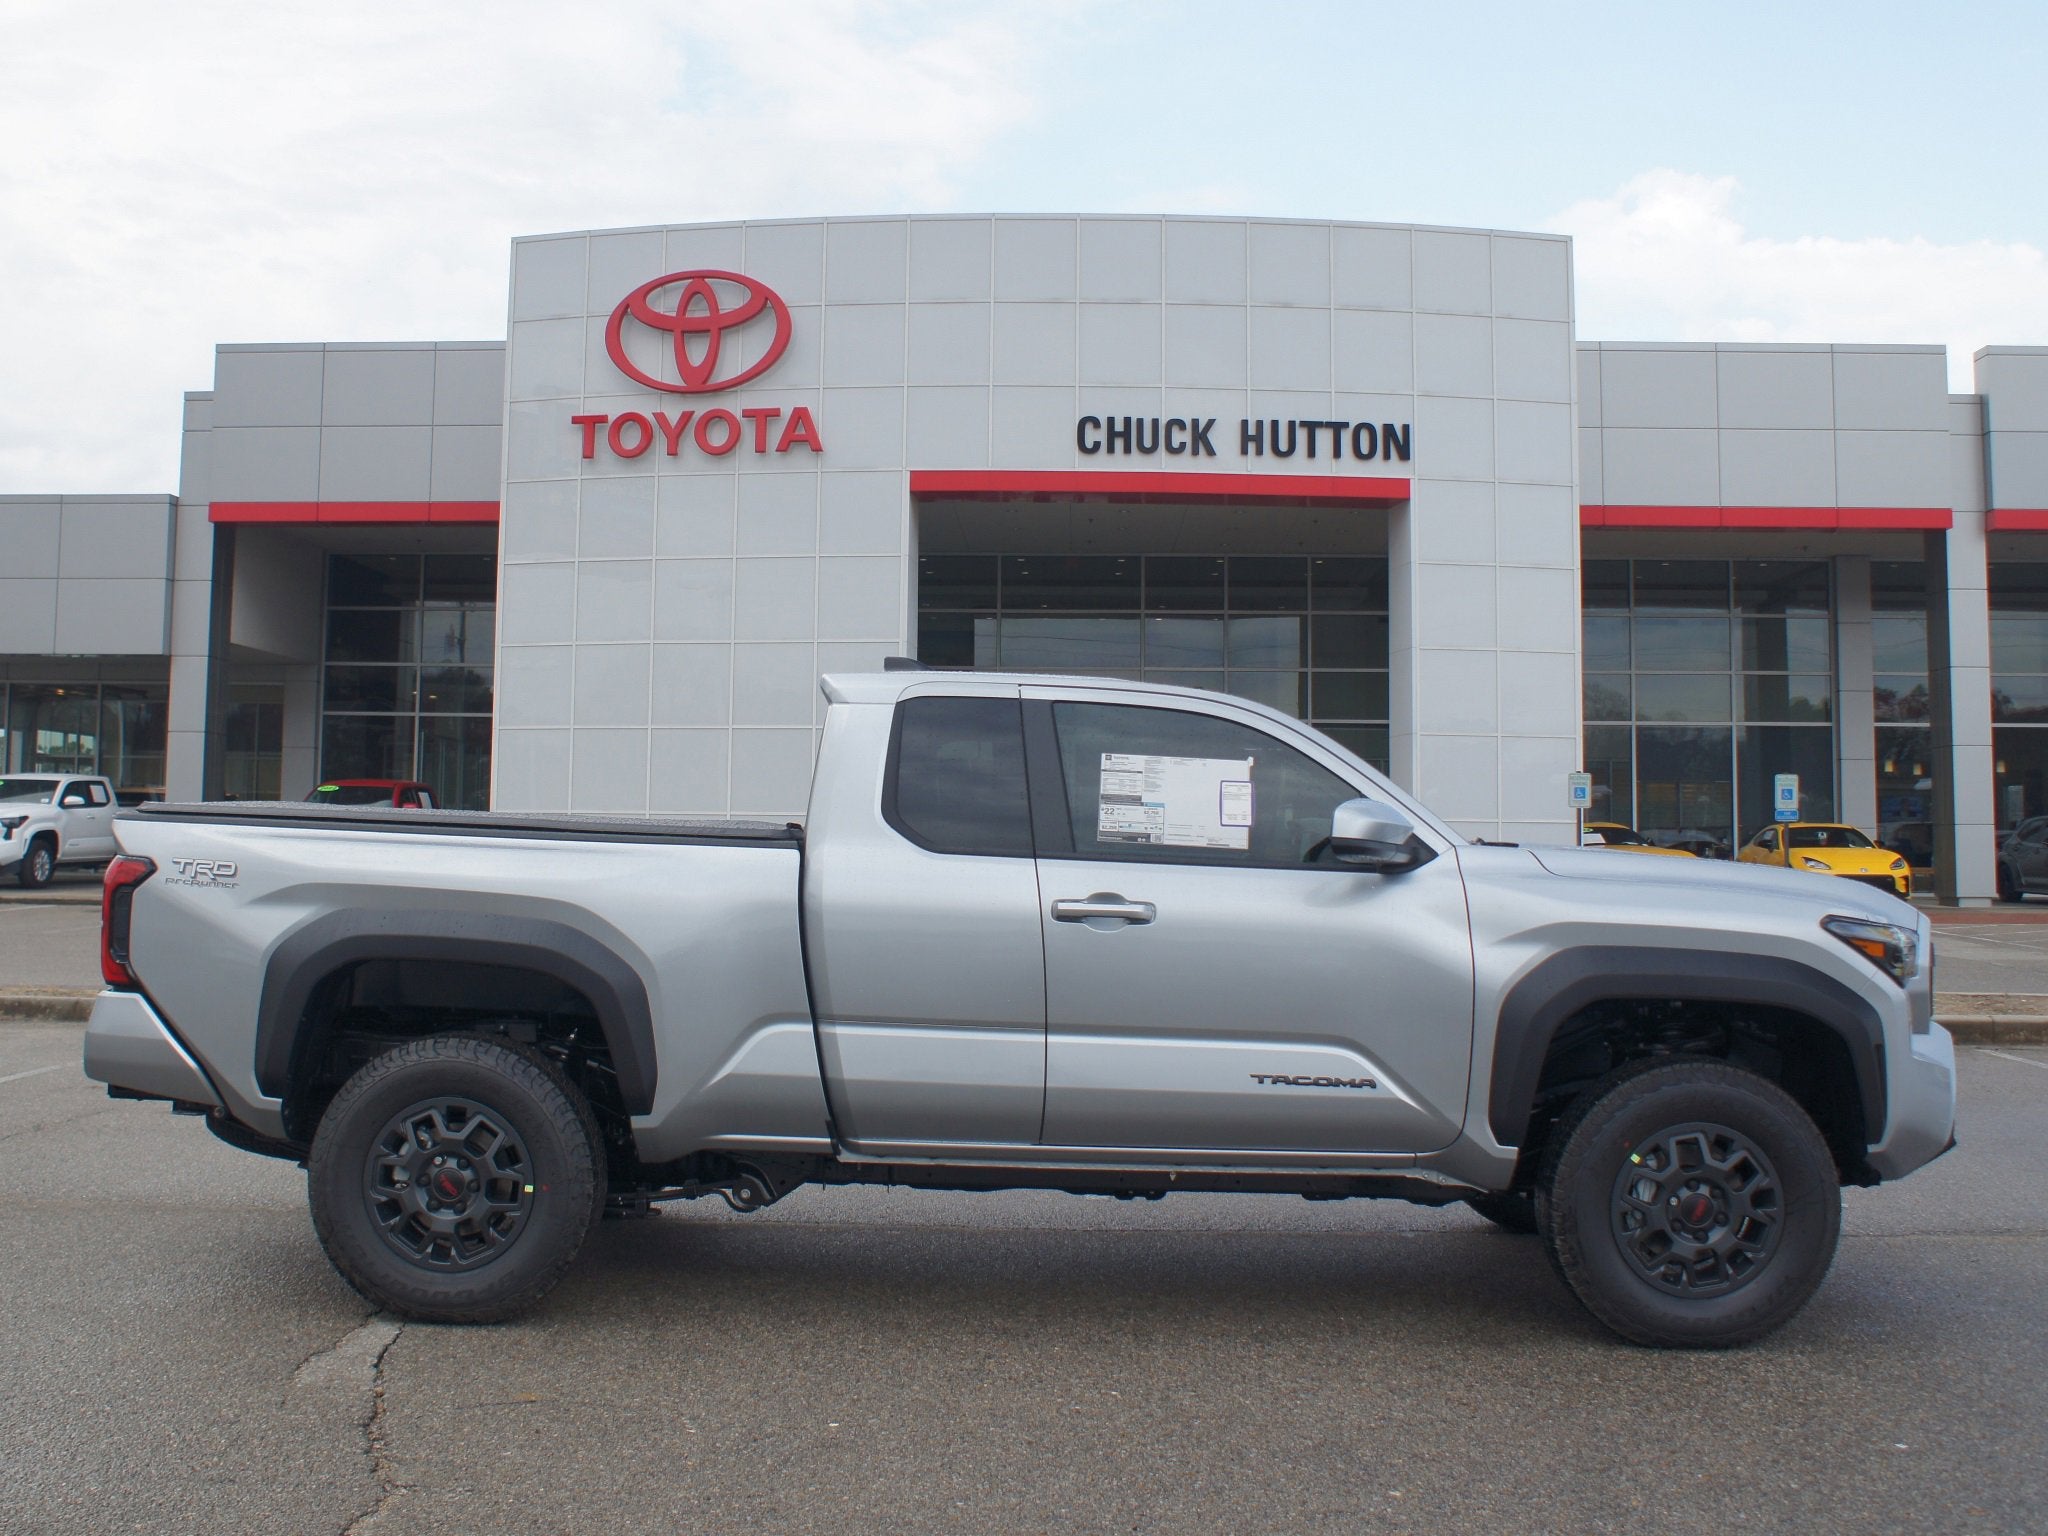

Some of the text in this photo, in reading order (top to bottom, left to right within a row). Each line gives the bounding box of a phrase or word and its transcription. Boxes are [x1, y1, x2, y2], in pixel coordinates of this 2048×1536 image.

[571, 407, 824, 459] TOYOTA
[1076, 415, 1411, 461] CHUCK HUTTON
[1103, 807, 1115, 815] 22
[172, 857, 238, 881] TRD
[1249, 1073, 1377, 1089] TACOMA
